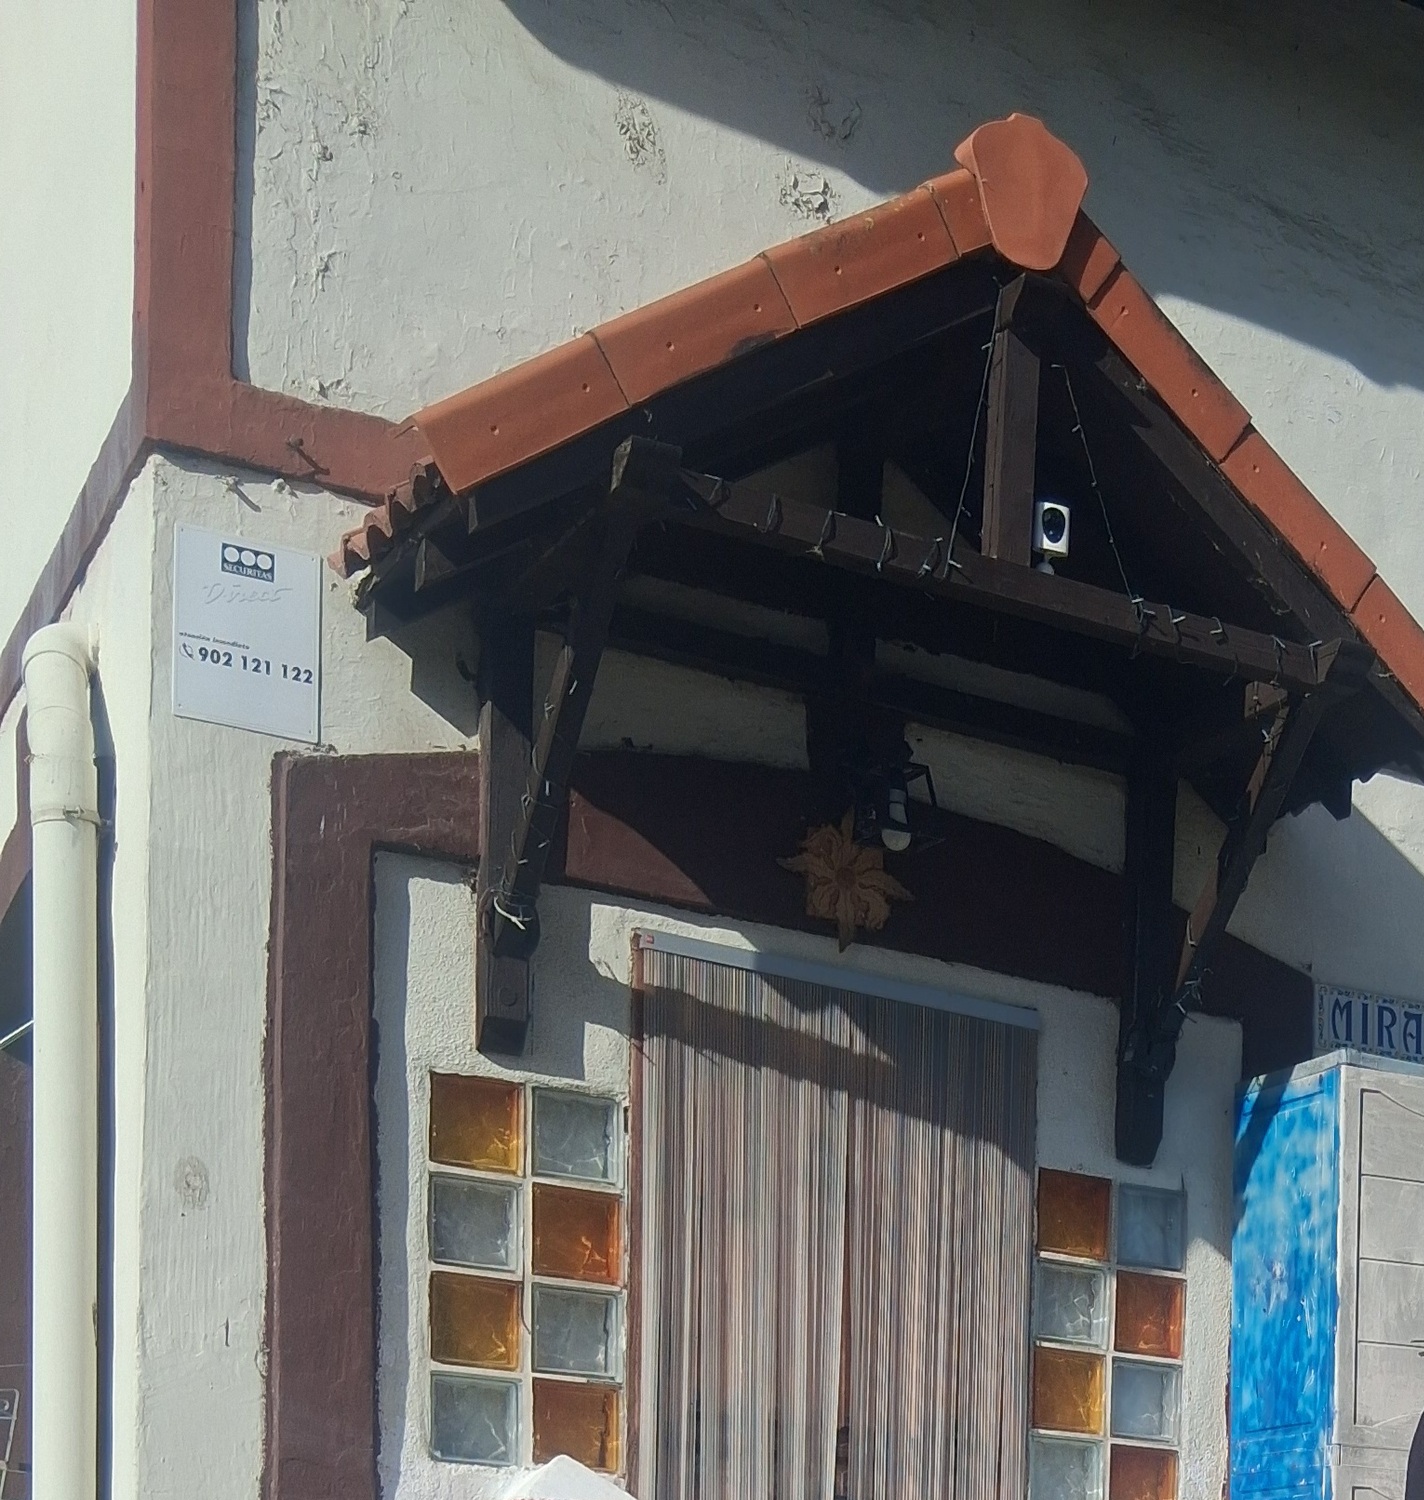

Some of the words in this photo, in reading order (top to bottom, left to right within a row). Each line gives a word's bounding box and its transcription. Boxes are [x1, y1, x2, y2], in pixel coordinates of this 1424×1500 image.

[223, 562, 273, 581] SECURITAS
[198, 646, 233, 668] 902
[241, 655, 271, 676] 121
[282, 663, 313, 685] 122
